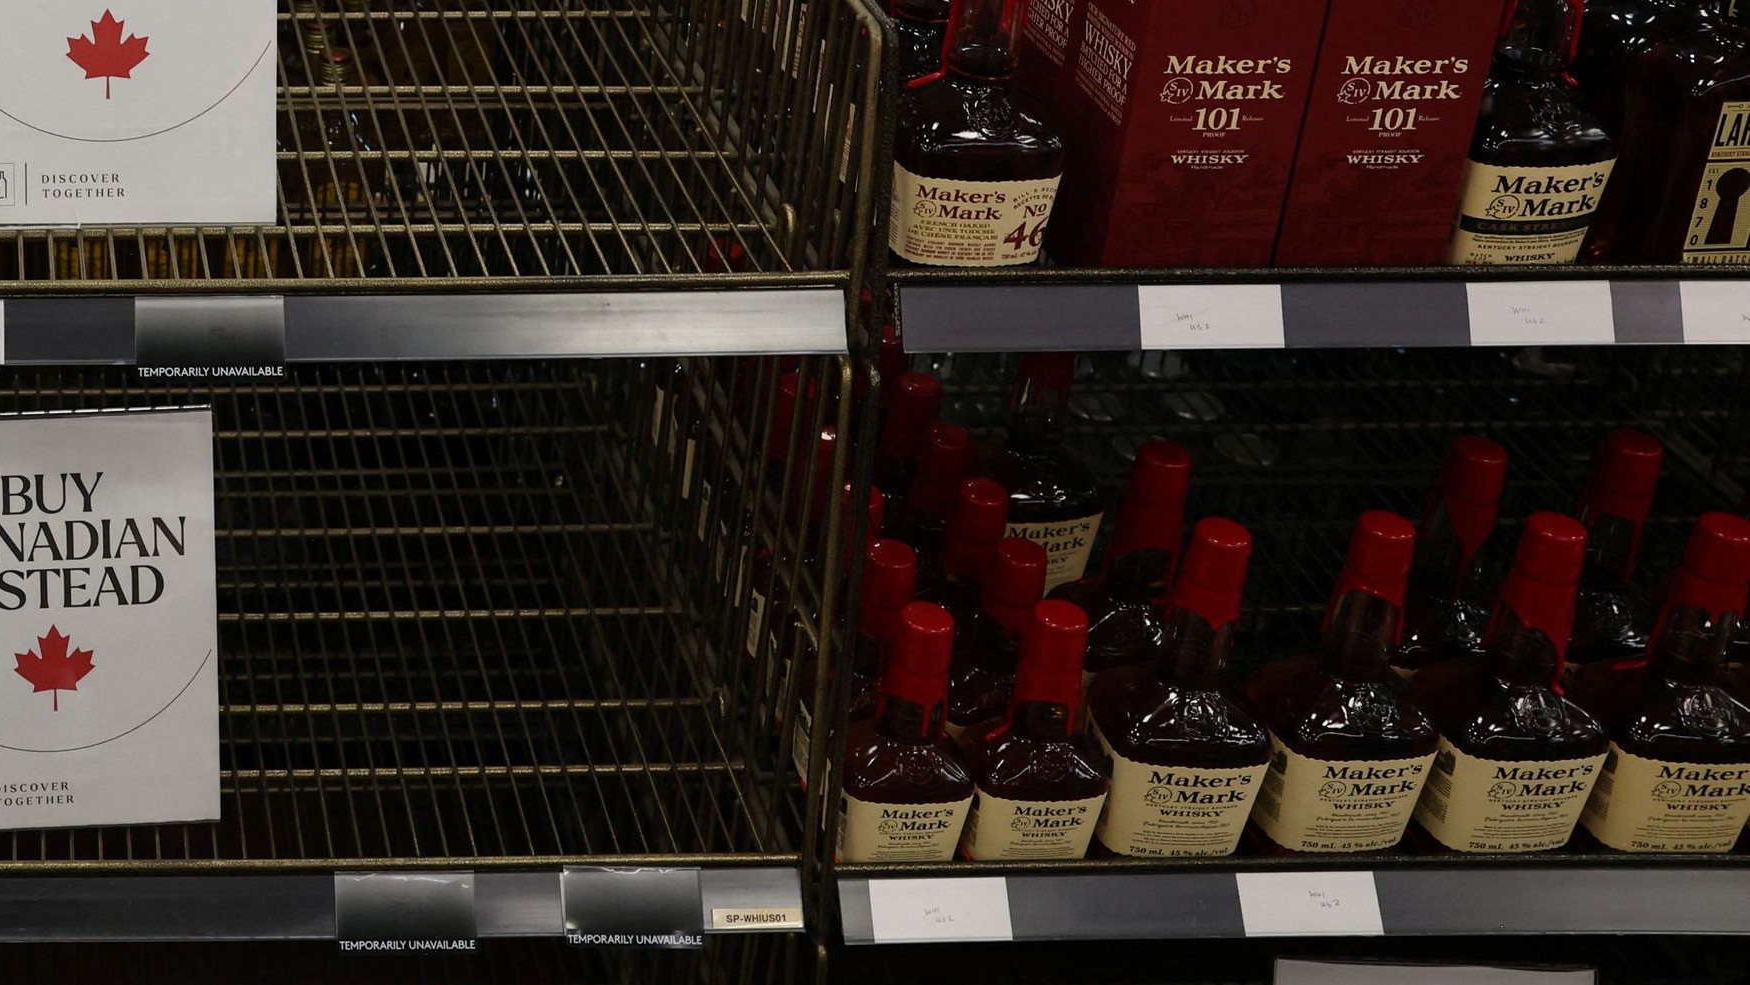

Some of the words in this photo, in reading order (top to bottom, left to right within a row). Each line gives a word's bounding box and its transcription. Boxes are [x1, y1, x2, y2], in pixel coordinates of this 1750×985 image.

[1085, 19, 1133, 80] WHISKY
[1080, 41, 1109, 75] BATCHED
[1163, 55, 1291, 75] Maker's
[1339, 55, 1467, 75] Maker's
[1078, 52, 1102, 85] HIGHER
[1102, 79, 1126, 106] PROOF
[1196, 80, 1284, 100] Mark
[1372, 80, 1460, 100] Mark
[1192, 107, 1241, 131] 101
[1368, 107, 1417, 131] 101
[1170, 154, 1249, 164] WHISKY
[1347, 154, 1425, 164] WHISKY
[41, 173, 120, 184] DISCOVER
[1492, 172, 1605, 194] Maker's
[42, 187, 126, 199] TOGETHER
[916, 184, 1006, 203] Maker's
[938, 204, 1003, 220] Mark
[1519, 194, 1596, 217] Mark
[1003, 217, 1048, 251] 46
[1504, 252, 1556, 262] WHISKY
[137, 366, 210, 378] TEMPORARILY
[213, 365, 284, 378] UNAVAILABLE
[1, 471, 104, 515] BUY
[1009, 522, 1090, 539] Maker's
[1147, 771, 1252, 788] Maker's
[1322, 764, 1423, 780] Maker's
[1492, 764, 1594, 780] Maker's
[1348, 780, 1418, 797] Mark
[1517, 780, 1587, 797] Mark
[1682, 783, 1750, 797] Mark
[1173, 790, 1246, 804] Mark
[1013, 805, 1088, 817] Maker's
[1333, 800, 1395, 810] WHISKY
[1502, 801, 1565, 811] WHISKY
[1666, 803, 1733, 811] WHISKY
[880, 808, 954, 820] Maker's
[1160, 809, 1225, 817] WHISKY
[900, 819, 950, 831] Mark
[1033, 817, 1083, 828] Mark
[1301, 840, 1319, 848] 750
[1469, 841, 1487, 849] 750
[726, 913, 788, 924] SP-WHIUS01
[339, 940, 406, 951] TEMPORARILY
[408, 939, 476, 950] UNAVAILABLE
[568, 934, 634, 946] TEMPORARILY
[635, 934, 702, 945] UNAVAILABLE
